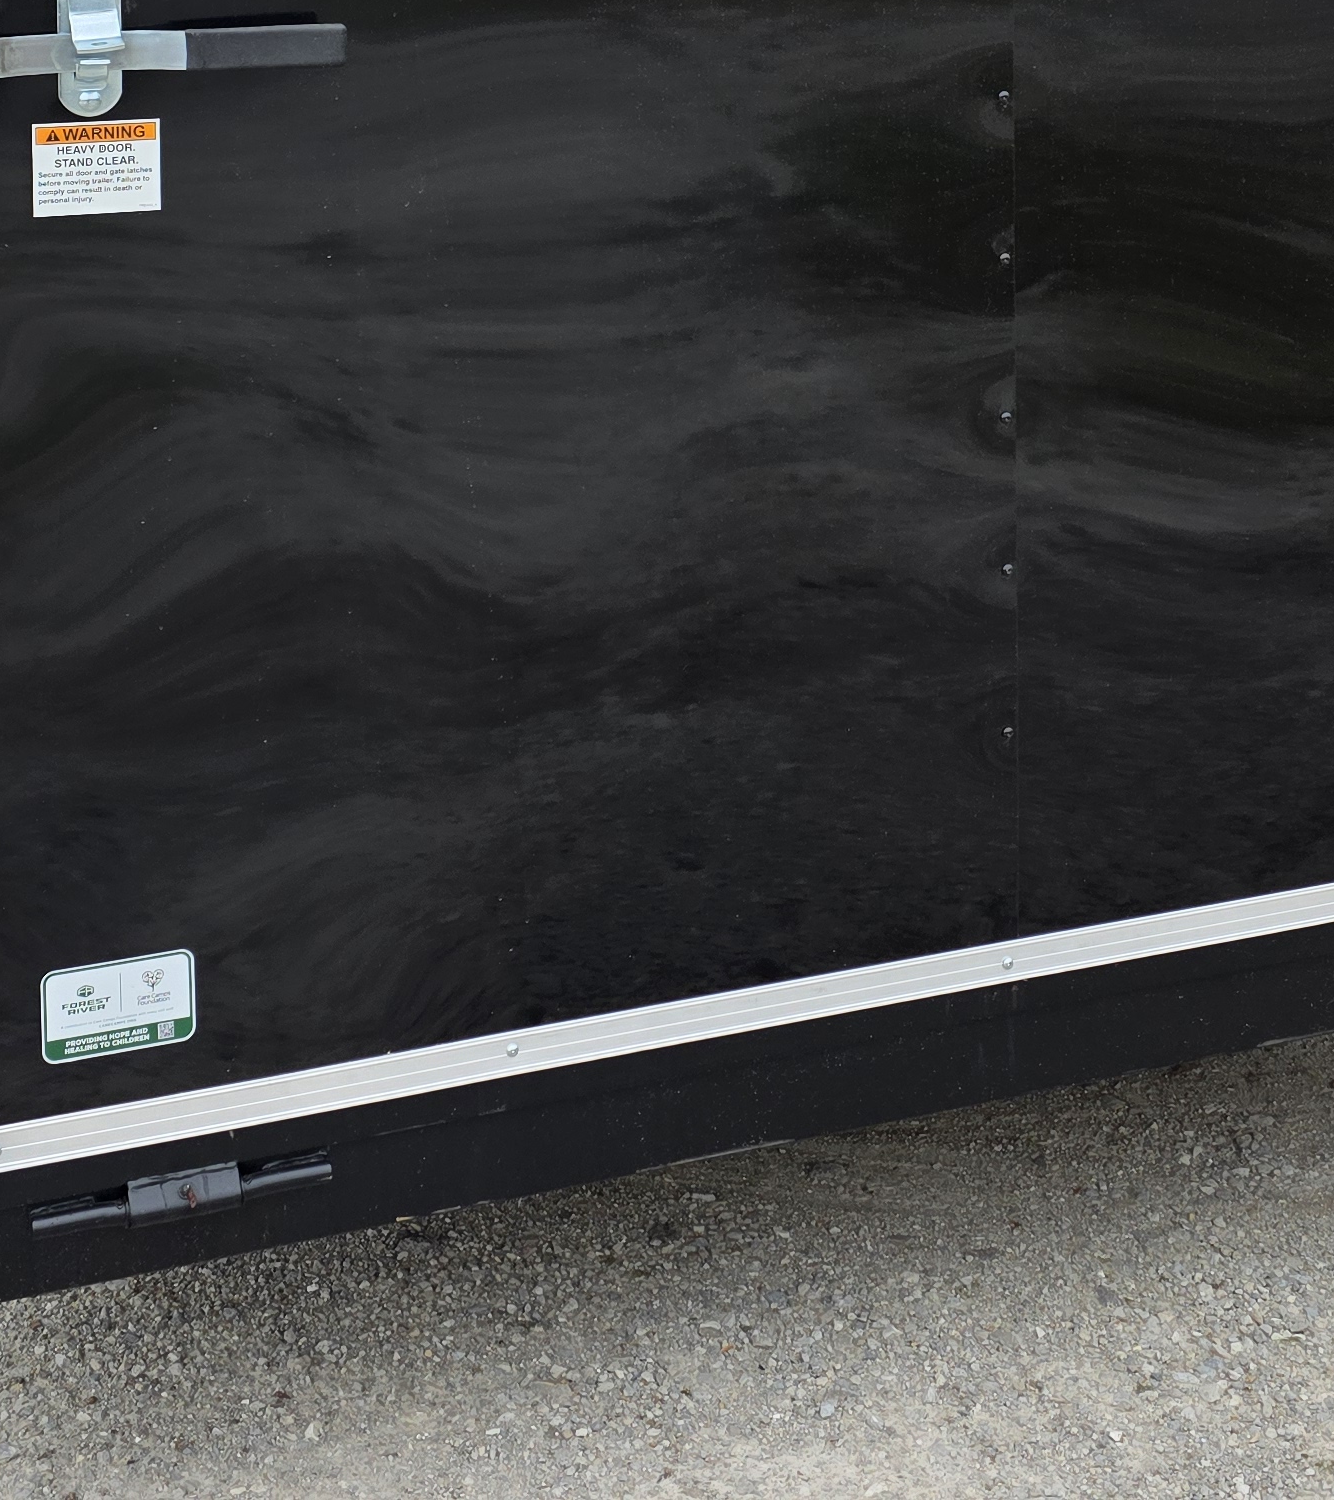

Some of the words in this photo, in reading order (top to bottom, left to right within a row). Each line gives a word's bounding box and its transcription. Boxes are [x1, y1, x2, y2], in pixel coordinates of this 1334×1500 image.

[62, 124, 146, 142] WARNING
[56, 144, 96, 156] HEAVY
[98, 143, 136, 154] DOOR.
[54, 157, 93, 169] STAND
[96, 155, 139, 167] CLEAR.
[37, 171, 63, 179] Secure
[109, 168, 126, 176] gate
[37, 180, 62, 188] before
[62, 178, 91, 187] moving
[116, 175, 141, 183] Failure
[37, 188, 65, 197] comply
[112, 184, 133, 192] death
[38, 196, 70, 206] personal
[71, 195, 95, 204] injury.
[61, 996, 112, 1011] FOREST
[67, 1003, 106, 1016] RIVER
[64, 1043, 99, 1055] HEALING
[99, 1040, 111, 1049] TO
[111, 1033, 150, 1047] CHILDREN
[65, 1034, 108, 1048] PROVIDING
[108, 1030, 130, 1040] HOPE
[131, 1027, 149, 1036] AND
